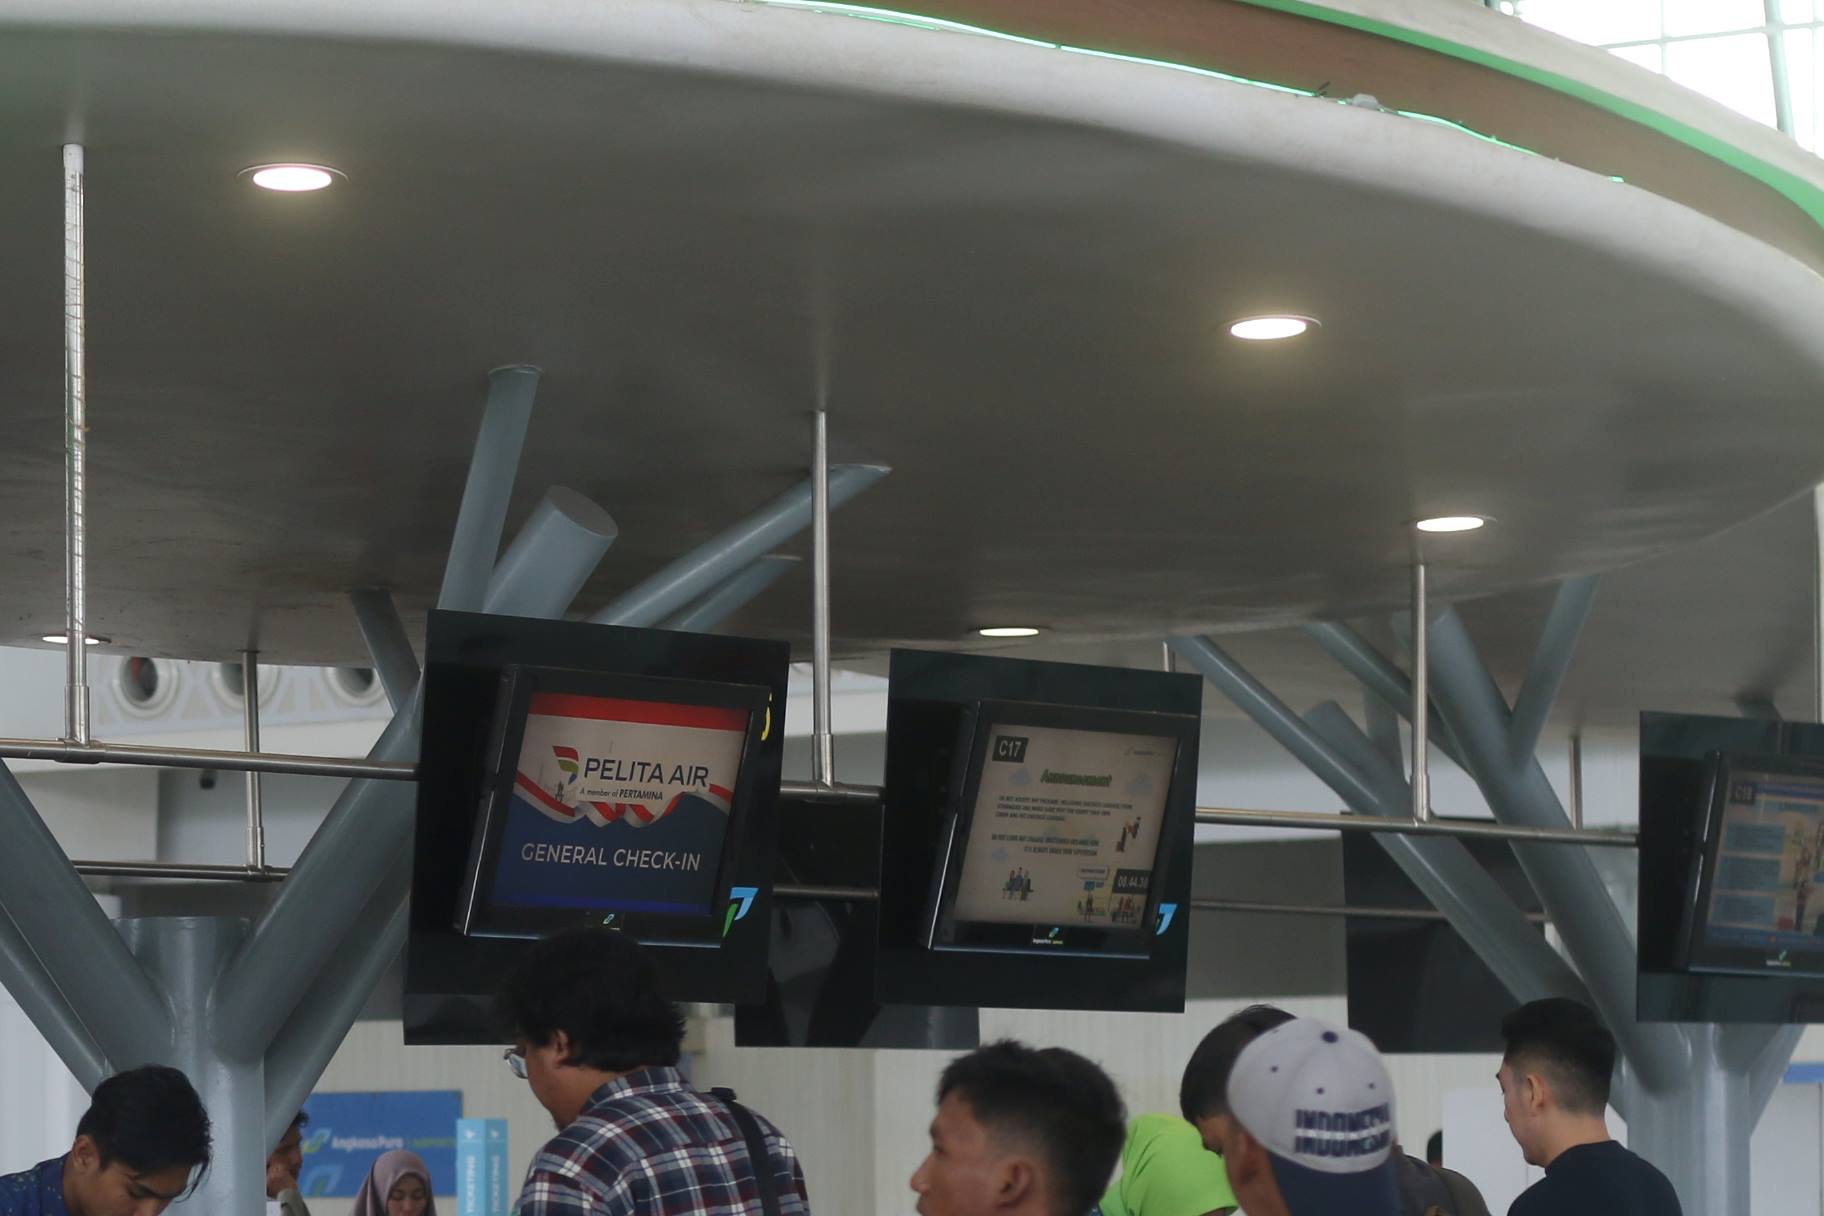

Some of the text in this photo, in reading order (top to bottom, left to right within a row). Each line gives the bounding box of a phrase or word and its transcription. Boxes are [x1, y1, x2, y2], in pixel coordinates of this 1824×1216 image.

[998, 739, 1022, 758] C17
[583, 757, 709, 787] PELITA AIR
[587, 789, 610, 797] member
[619, 789, 663, 801] PERTAMINA
[521, 842, 701, 871] GENERAL CHECK-IN
